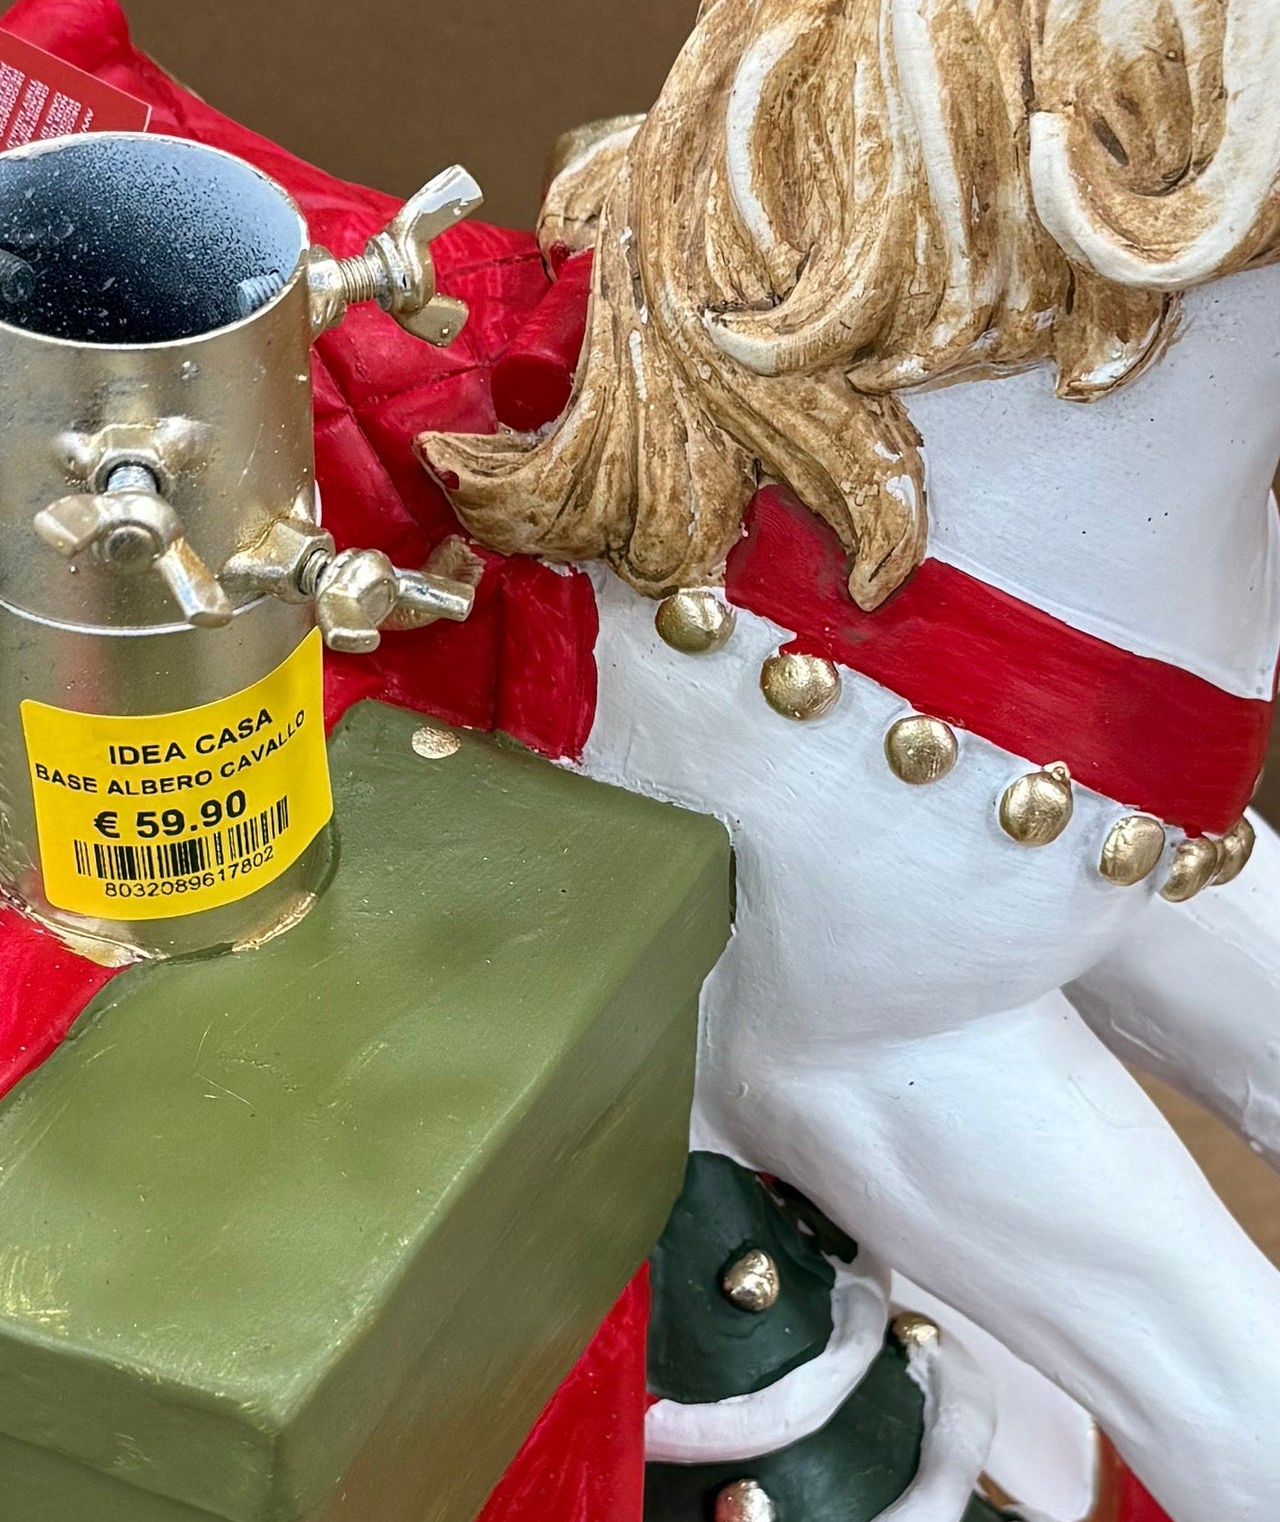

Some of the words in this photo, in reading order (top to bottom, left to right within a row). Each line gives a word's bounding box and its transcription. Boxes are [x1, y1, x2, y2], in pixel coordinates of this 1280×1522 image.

[35, 763, 98, 794] BASE
[107, 770, 212, 795] ALBERO
[220, 709, 305, 778] CAVALLO
[109, 742, 186, 765] IDEA
[195, 708, 273, 754] CASA
[94, 810, 120, 838] €
[136, 789, 246, 838] 59.90
[105, 845, 274, 897] 8032089617802
